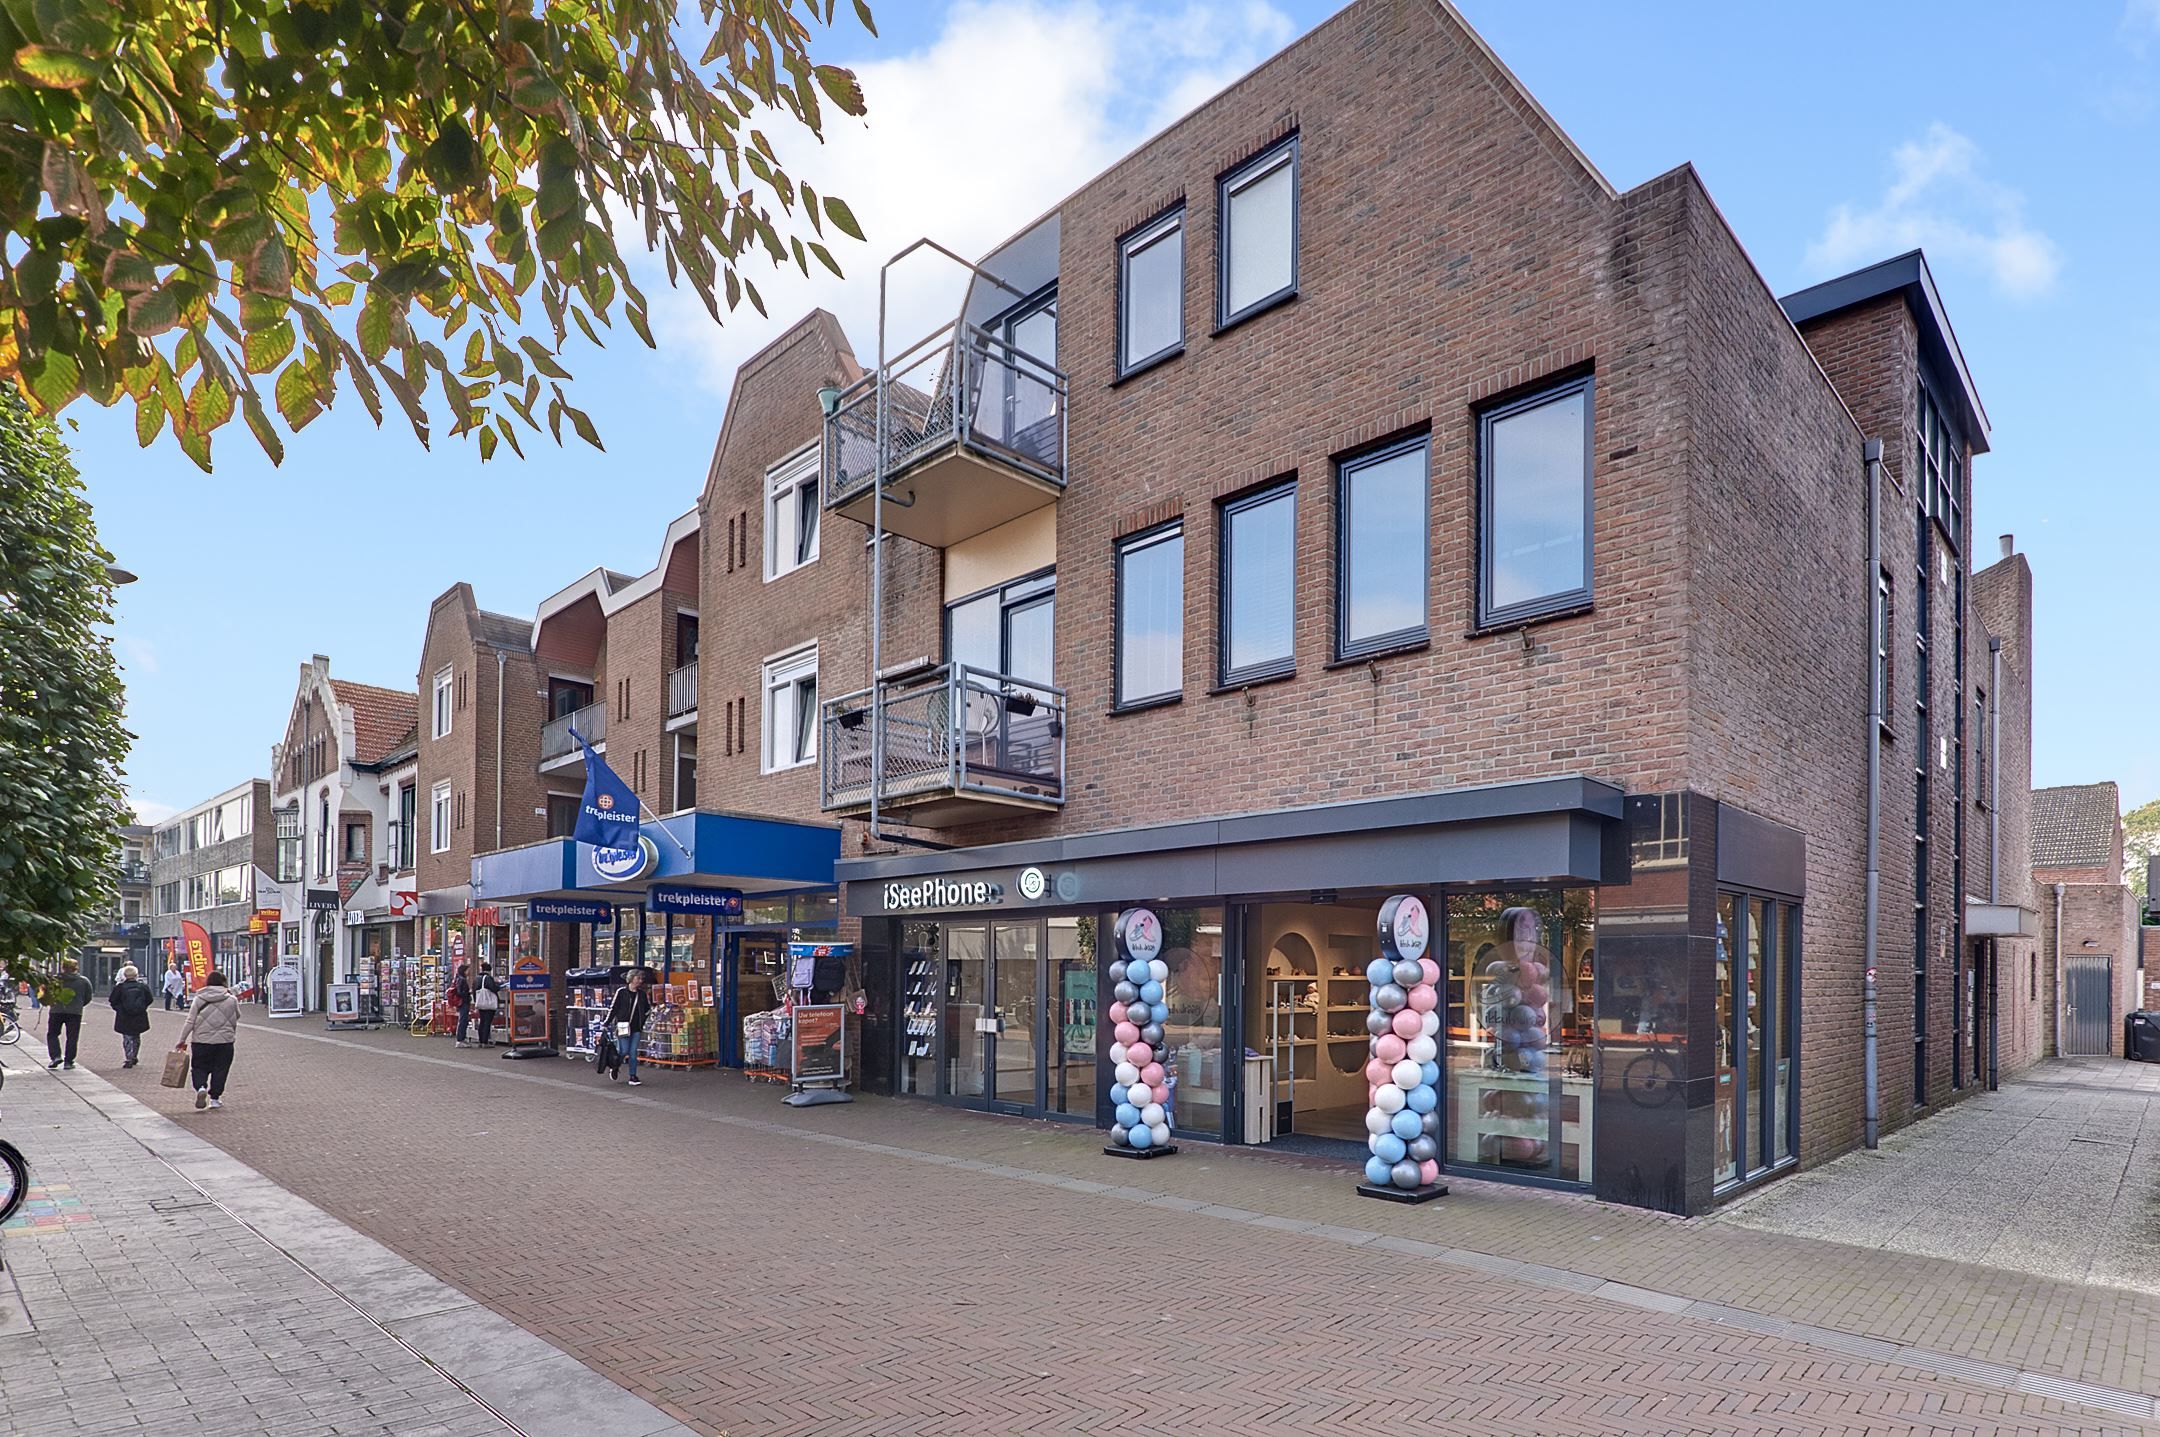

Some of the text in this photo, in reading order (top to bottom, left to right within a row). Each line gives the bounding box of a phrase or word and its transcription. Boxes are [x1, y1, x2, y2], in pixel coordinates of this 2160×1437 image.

[585, 805, 636, 823] trepleister
[657, 892, 727, 907] trekpleister
[884, 878, 986, 910] iSeePhone
[536, 904, 597, 916] trekpleister
